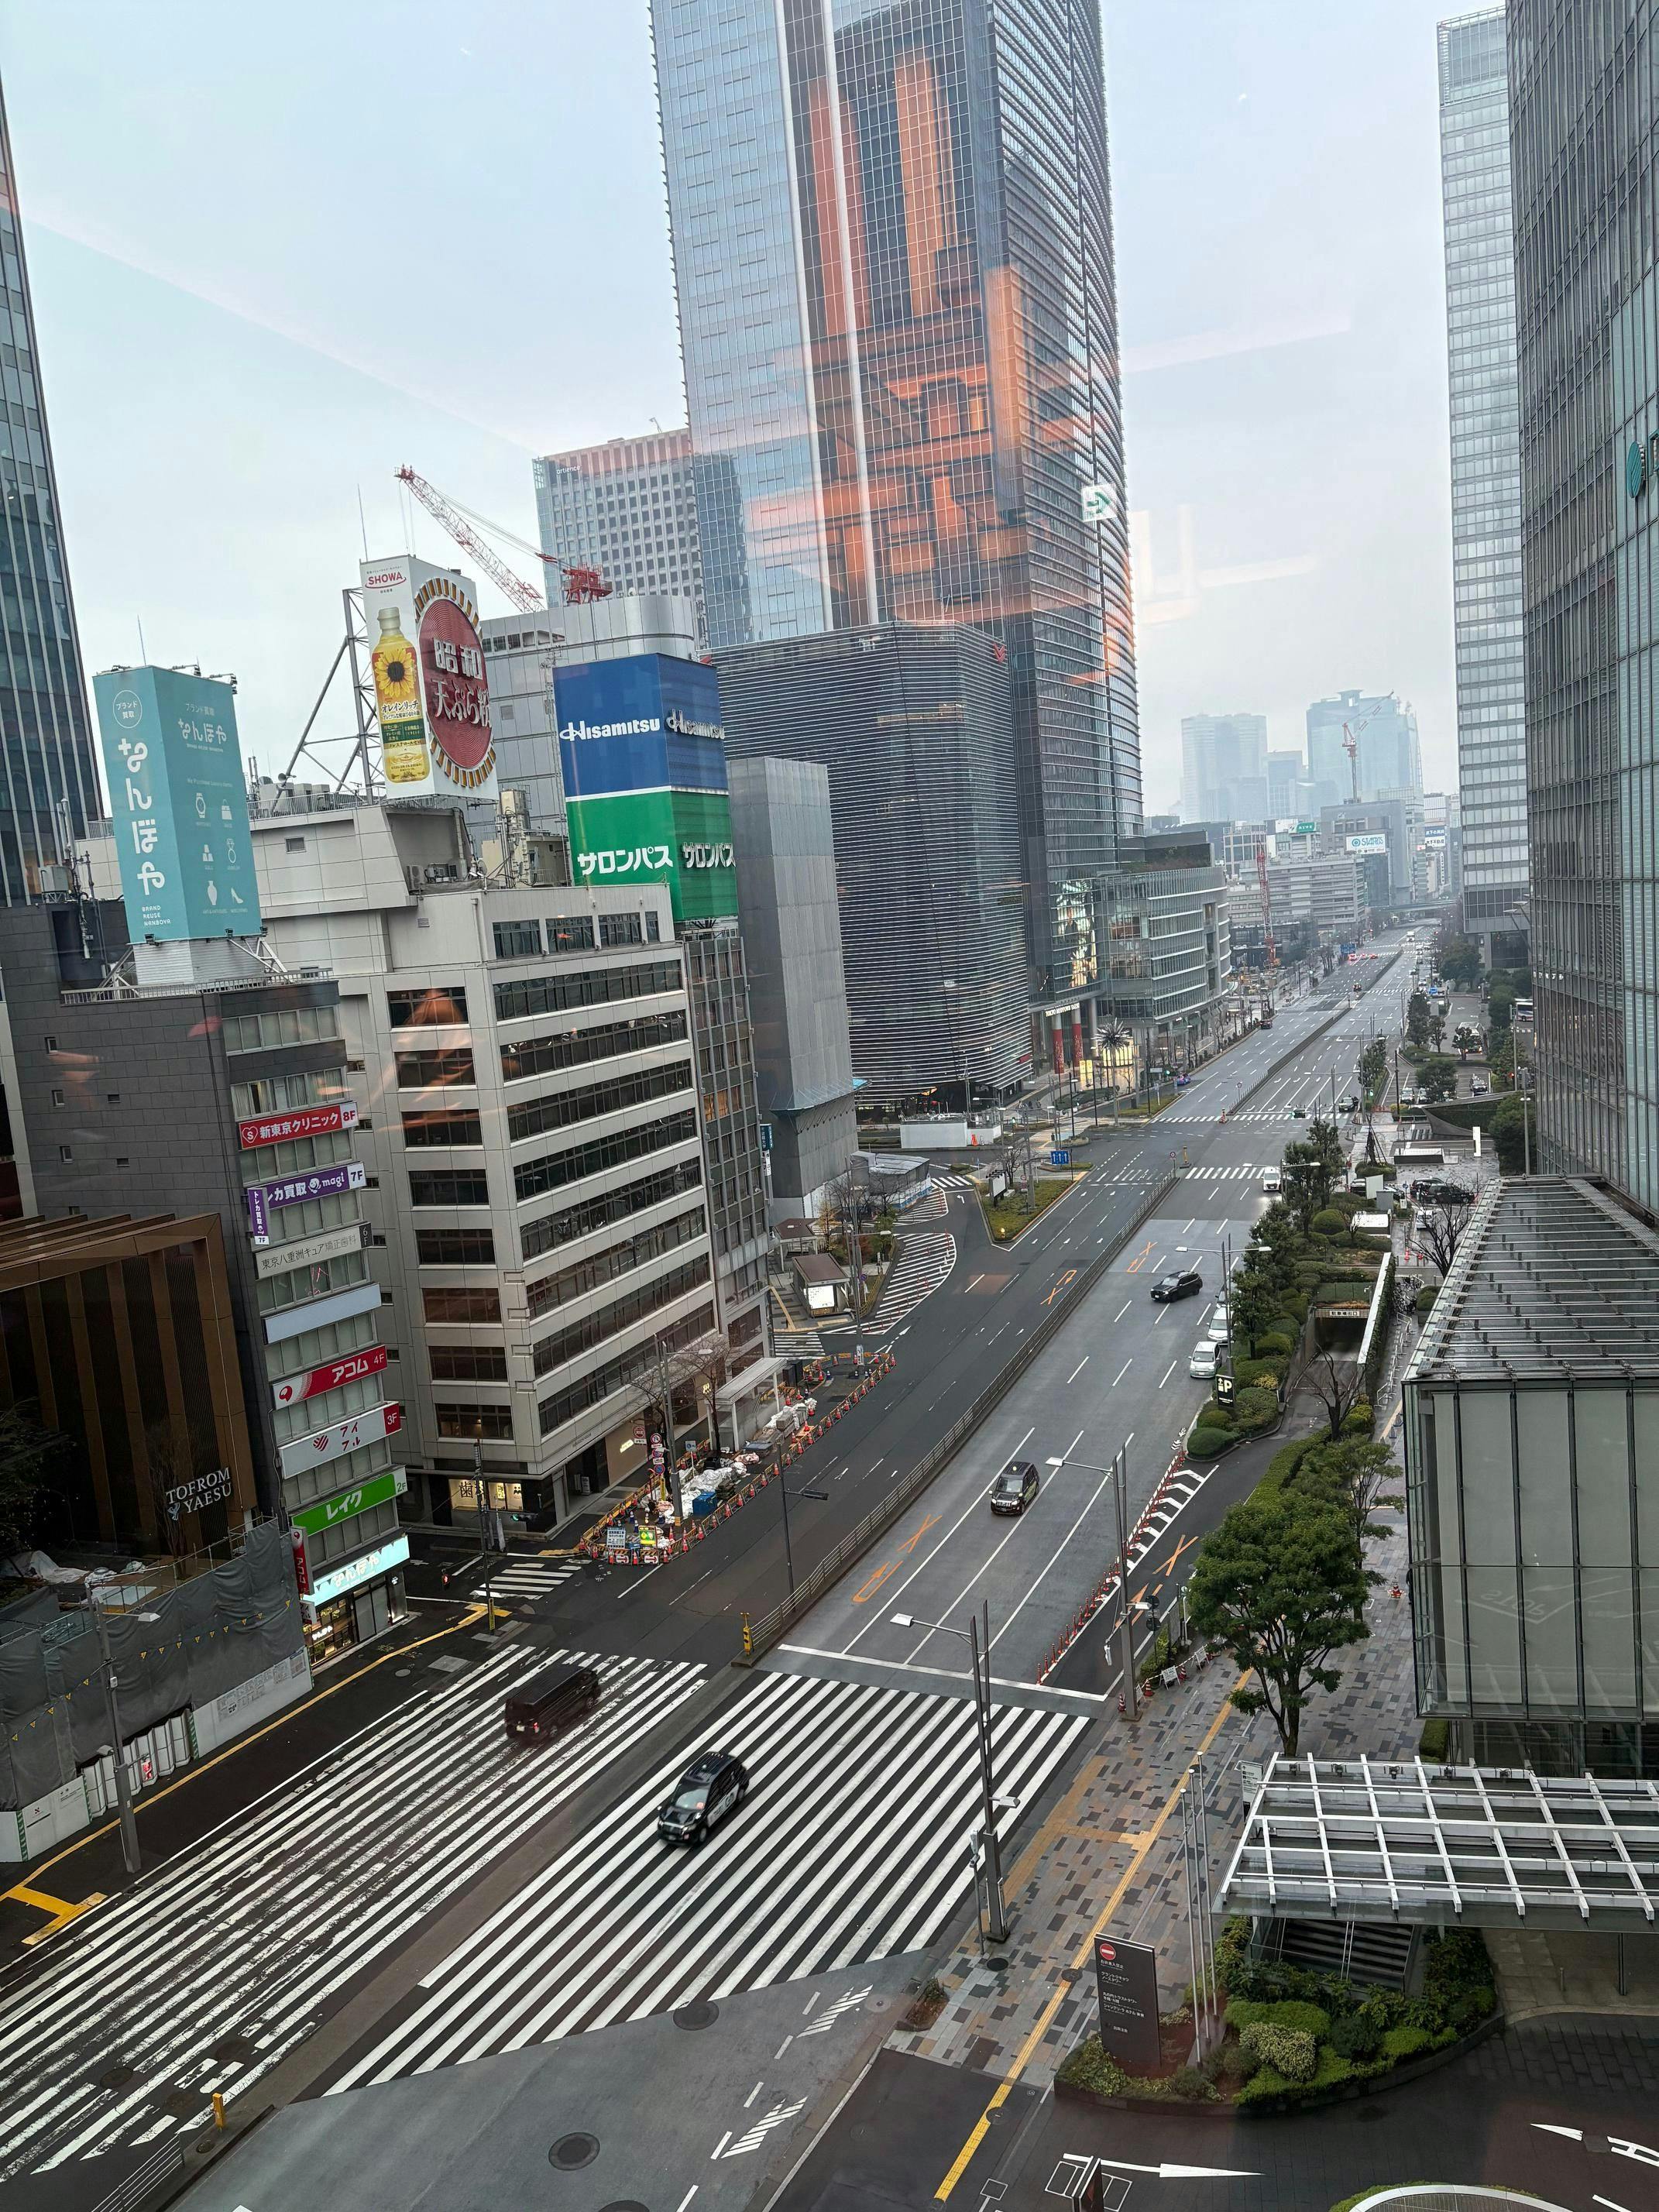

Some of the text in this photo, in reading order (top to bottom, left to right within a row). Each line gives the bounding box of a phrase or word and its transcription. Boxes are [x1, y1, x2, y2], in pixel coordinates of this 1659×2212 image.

[368, 571, 403, 585] SHOWA
[433, 637, 483, 680] 昭和
[115, 700, 138, 711] ブランド
[122, 711, 135, 720] 買取
[185, 702, 215, 716] ブランド買取
[382, 699, 419, 713] オレインリッチ
[430, 678, 493, 728] 天ぷら粉
[177, 718, 227, 744] なんぼや
[559, 718, 661, 741] Hisamitsu
[665, 708, 726, 740] Hisamitsu
[118, 737, 165, 895] なんぼや
[577, 845, 674, 876] サロンパス
[682, 841, 737, 869] サロンパス
[259, 1113, 338, 1139] 新東京クリニック
[342, 1110, 356, 1121] 8F
[267, 1170, 363, 1202] カ買取 magi 7F
[254, 1191, 263, 1224] トレカ買取
[261, 1235, 356, 1270] 東京八重洲キュア矯正歯科
[331, 1353, 385, 1383] アコム 4F
[1224, 1379, 1232, 1393] P
[340, 1412, 397, 1437] アイ 3F
[342, 1437, 361, 1451] フル
[166, 1467, 231, 1504] TOFROM
[184, 1482, 232, 1513] YAESU
[326, 1482, 407, 1520] レイク 2F
[296, 1557, 306, 1585] アコム
